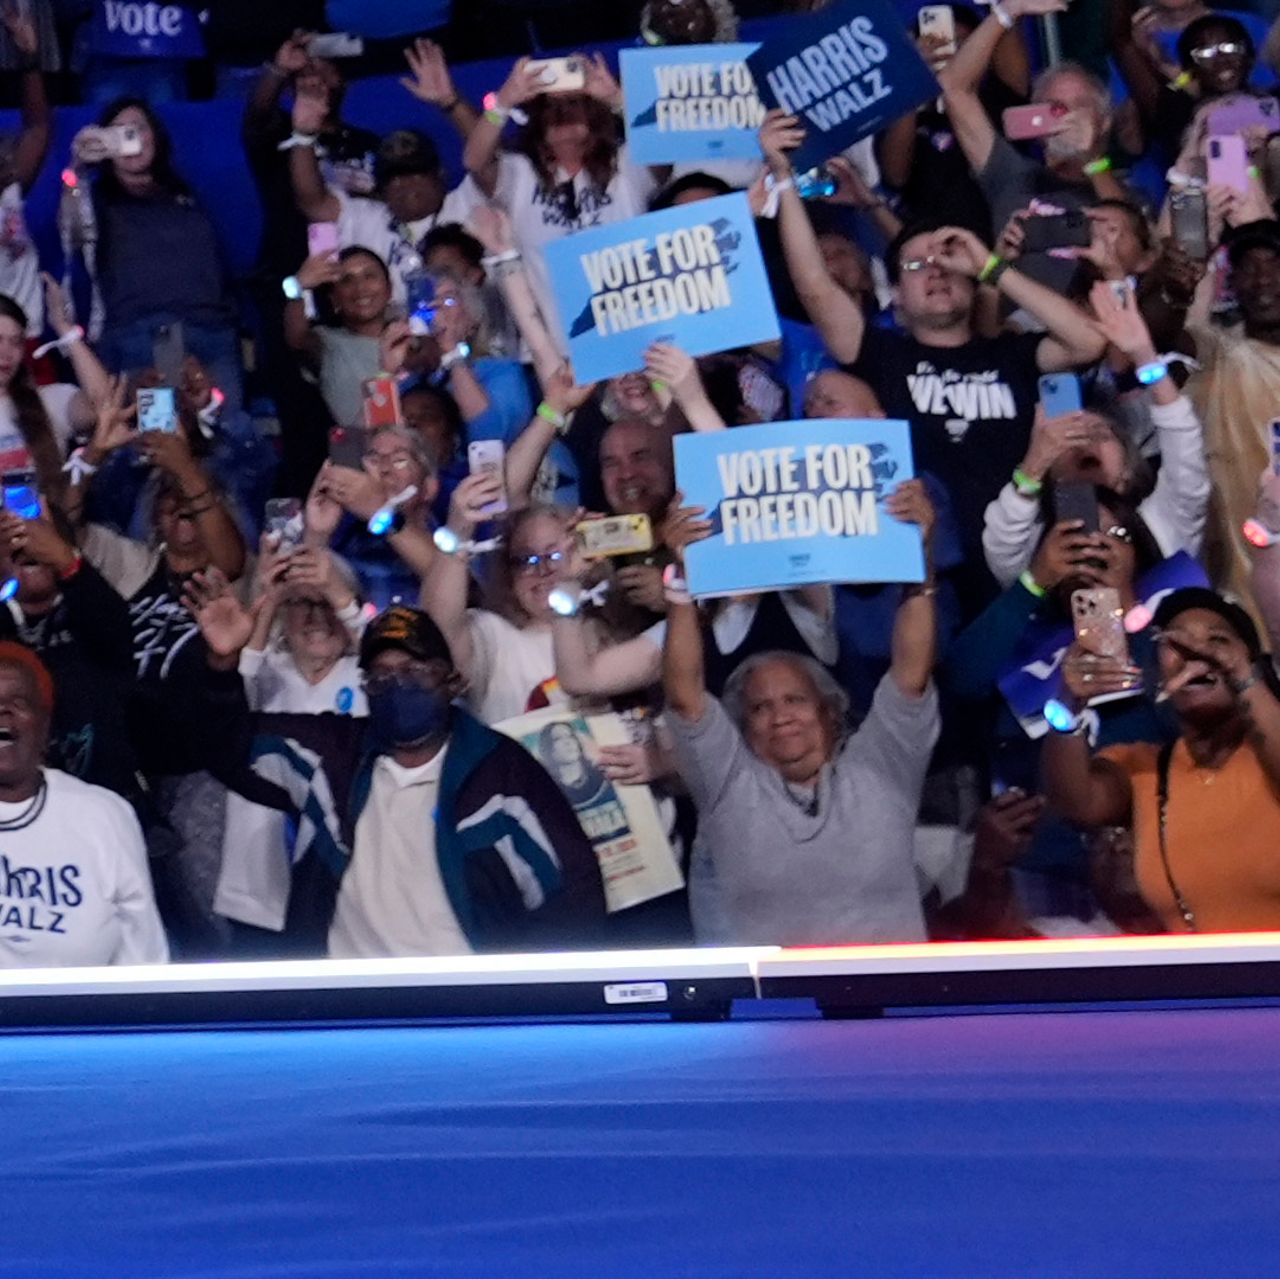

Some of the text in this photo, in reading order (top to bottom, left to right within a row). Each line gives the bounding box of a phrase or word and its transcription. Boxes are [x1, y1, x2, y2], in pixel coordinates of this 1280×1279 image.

[653, 60, 758, 99] VOTE FO
[766, 15, 889, 116] HARRIS
[804, 68, 894, 133] WALZ
[579, 223, 722, 294] VOTE FOR
[589, 262, 733, 338] FREEDOM
[905, 373, 1018, 422] WE WIN
[716, 443, 875, 497] VOTE FOR
[719, 489, 880, 546] FREEDOM
